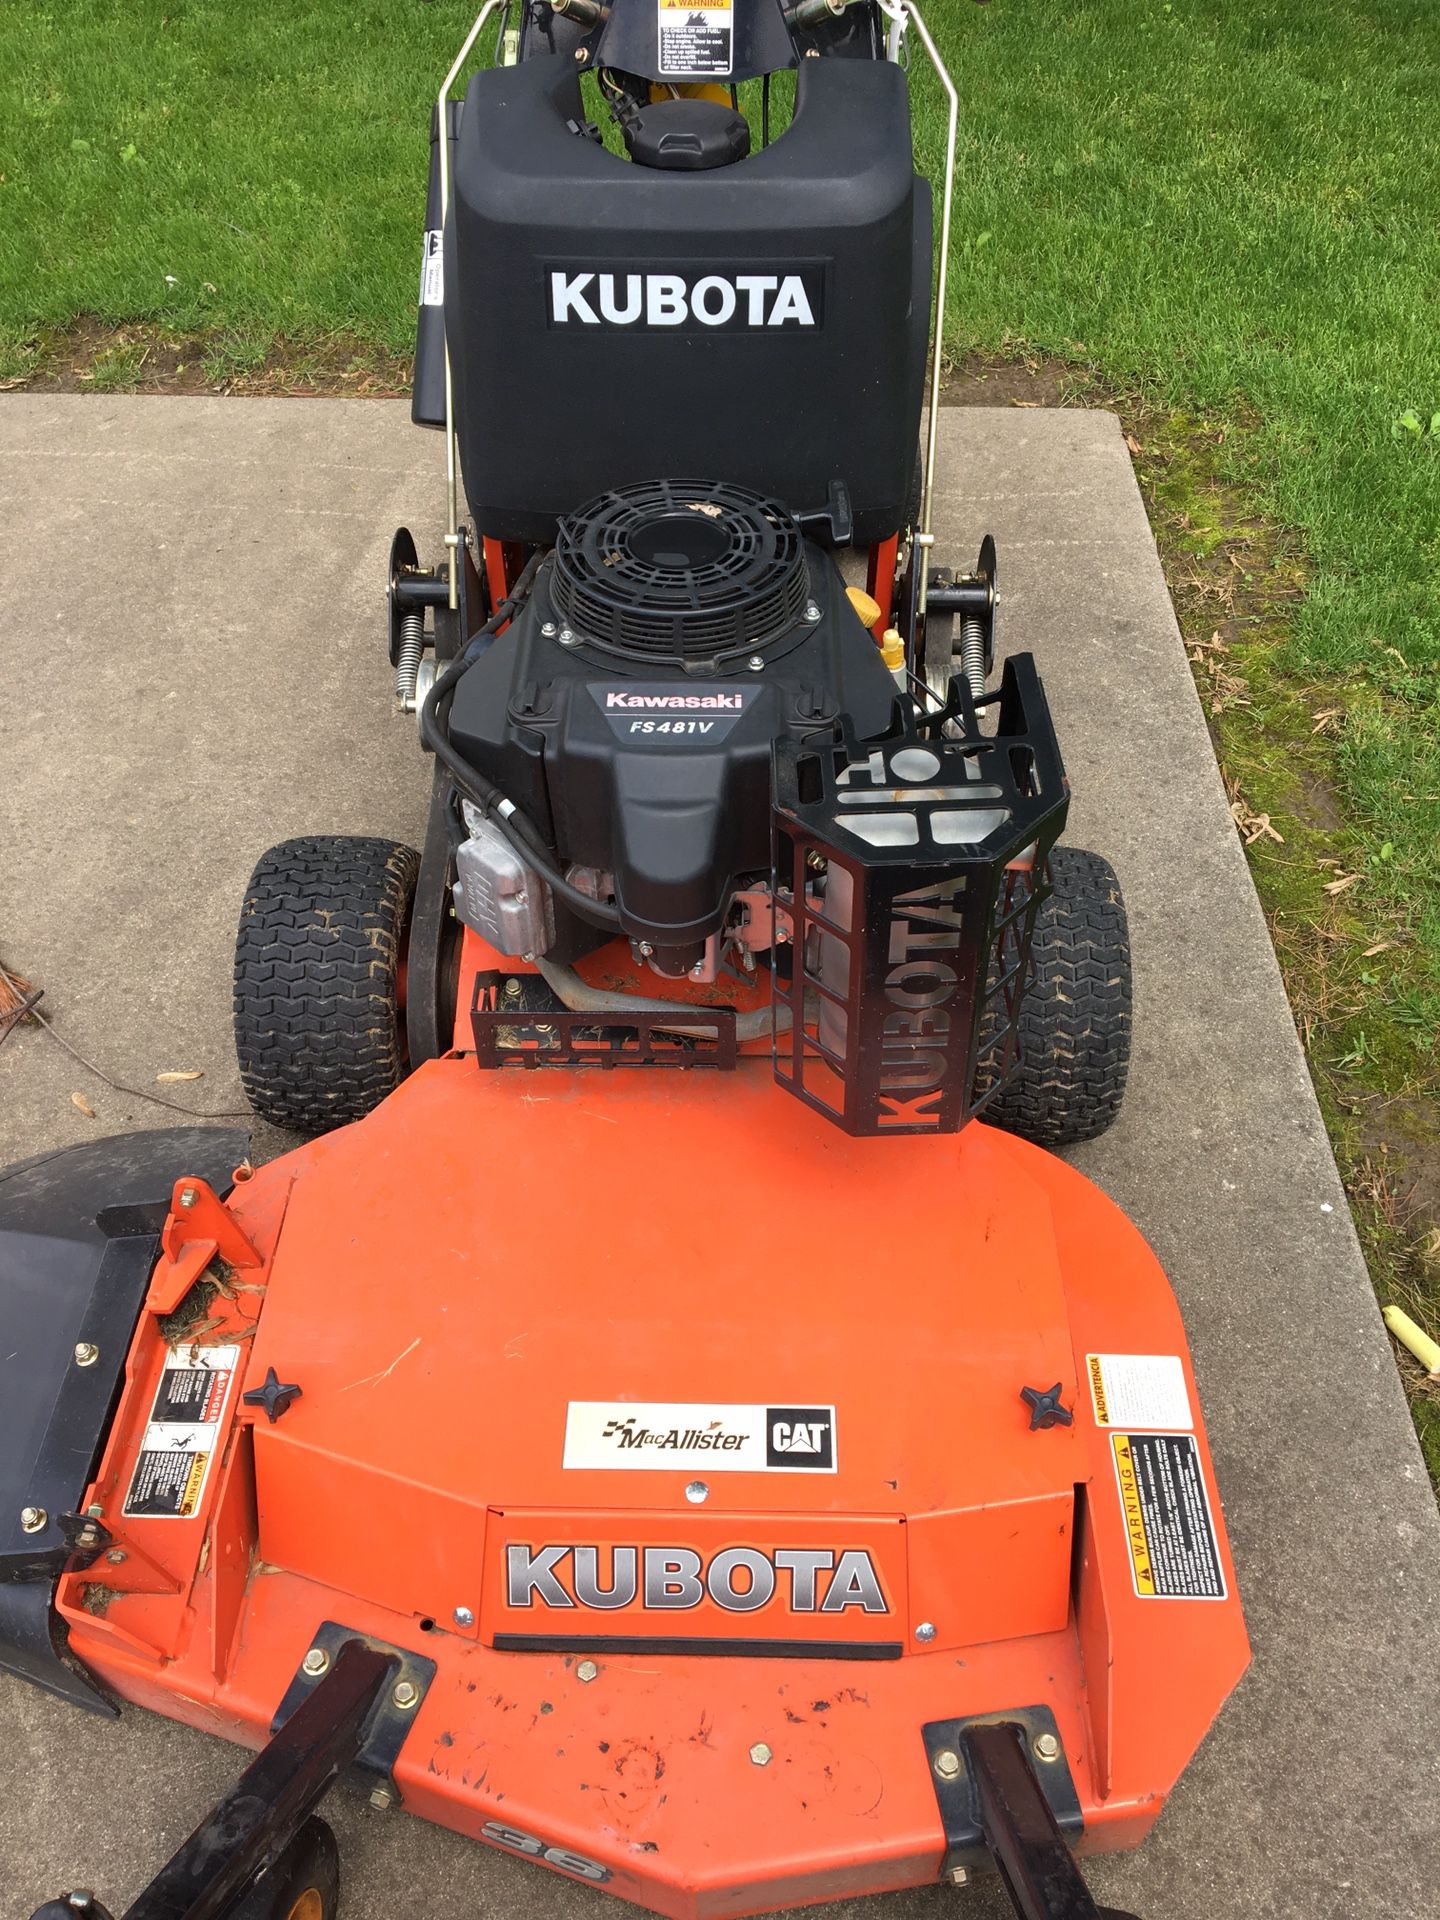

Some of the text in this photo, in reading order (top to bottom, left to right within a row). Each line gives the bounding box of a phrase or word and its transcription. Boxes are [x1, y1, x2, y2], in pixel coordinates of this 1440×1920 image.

[551, 272, 815, 326] KUBOTA
[606, 693, 742, 708] Kawasaki
[629, 721, 714, 734] FS481V
[877, 875, 966, 1128] KUBOTA
[199, 1371, 216, 1420] ROTATING BLADES
[208, 1381, 225, 1422] DANGER
[1090, 1357, 1106, 1411] ADVERTENCIA
[617, 1422, 750, 1451] MacAllister
[772, 1423, 830, 1453] CAT
[1131, 1446, 1137, 1454] OR
[174, 1456, 193, 1509] THROWN OBJECTS
[1132, 1454, 1140, 1472] COVER
[183, 1464, 202, 1513] WARNIN
[1121, 1468, 1145, 1556] WARNING
[1169, 1521, 1177, 1538] LEAST
[1165, 1536, 1174, 1558] TURNED
[507, 1546, 889, 1613] KUBOTA
[480, 1822, 612, 1883] 36
